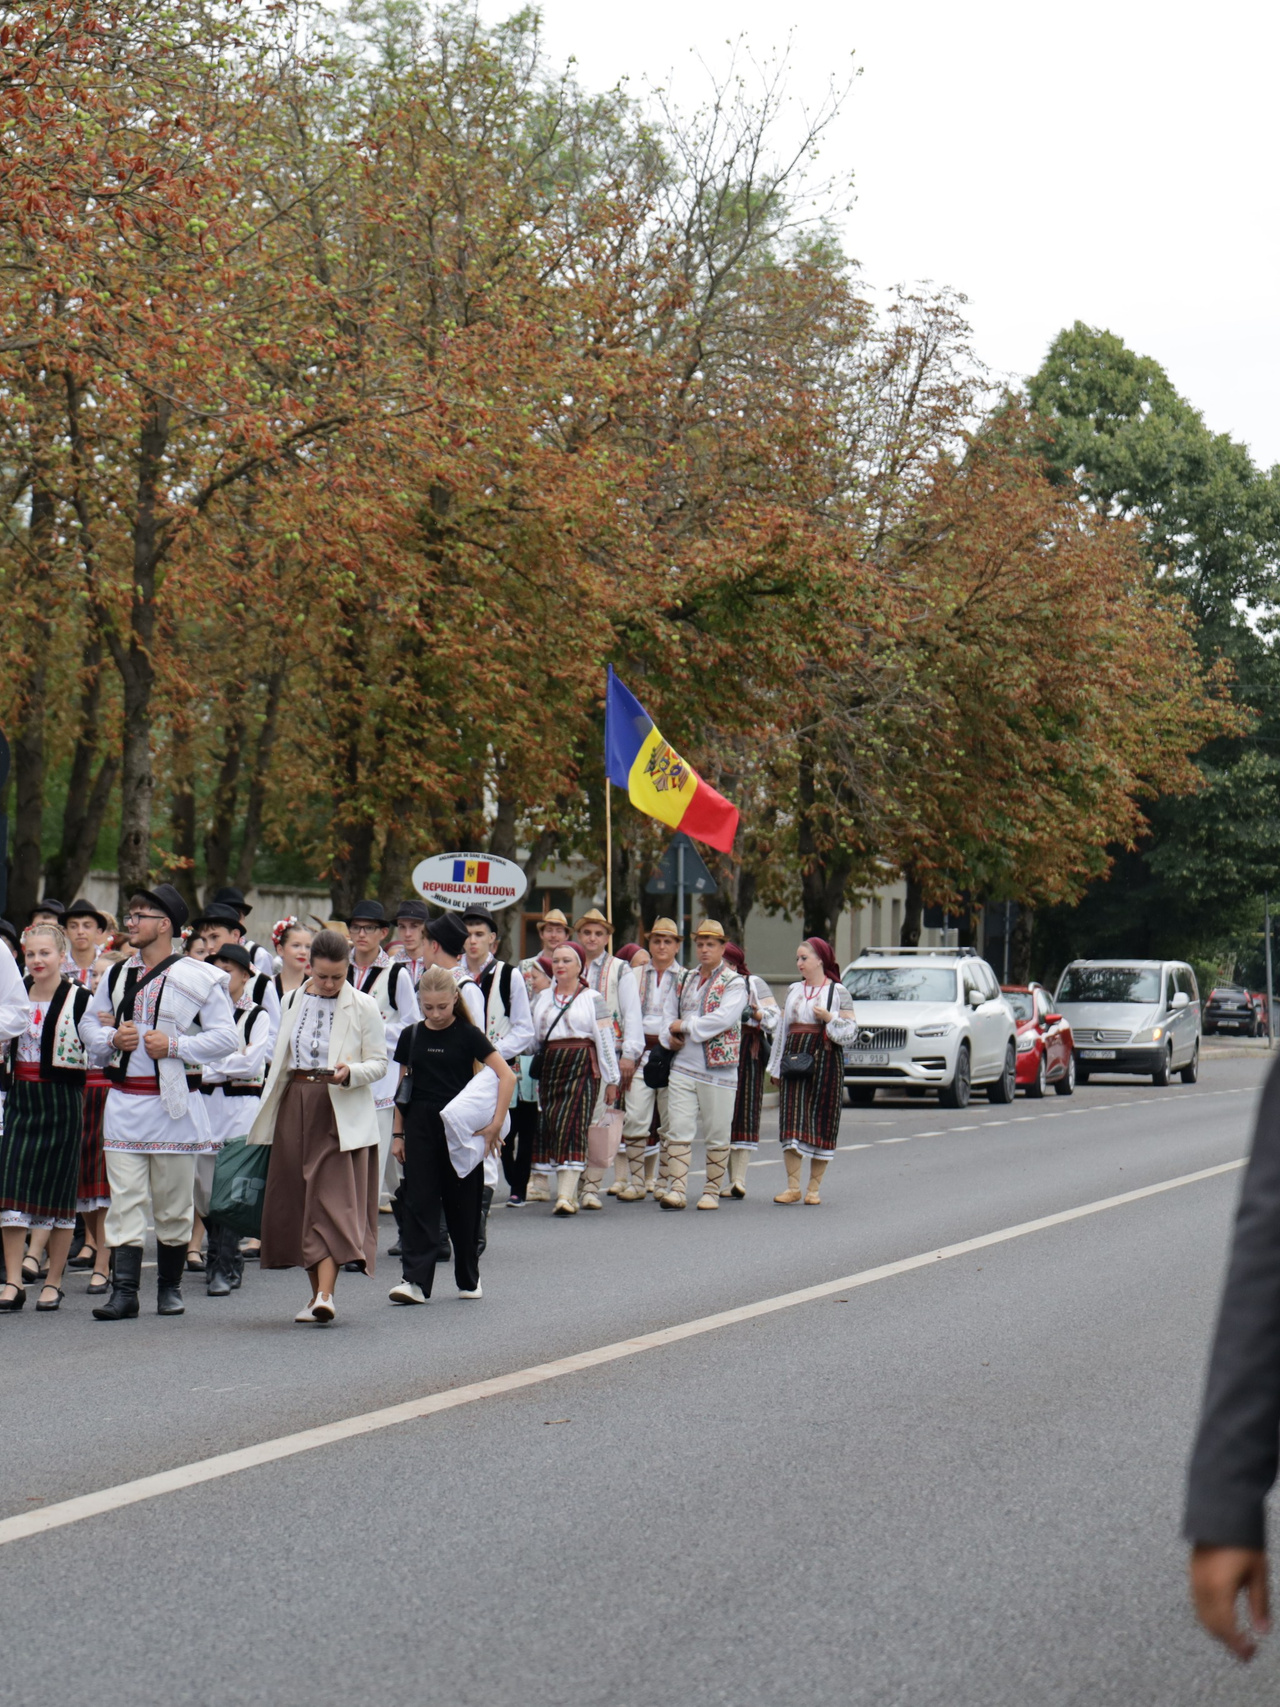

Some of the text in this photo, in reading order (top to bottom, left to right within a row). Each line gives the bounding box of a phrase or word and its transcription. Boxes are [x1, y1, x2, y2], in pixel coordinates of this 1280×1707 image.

[423, 881, 516, 896] REPUBLICA MOLDOVA
[452, 900, 460, 908] DE
[869, 1054, 884, 1063] 918
